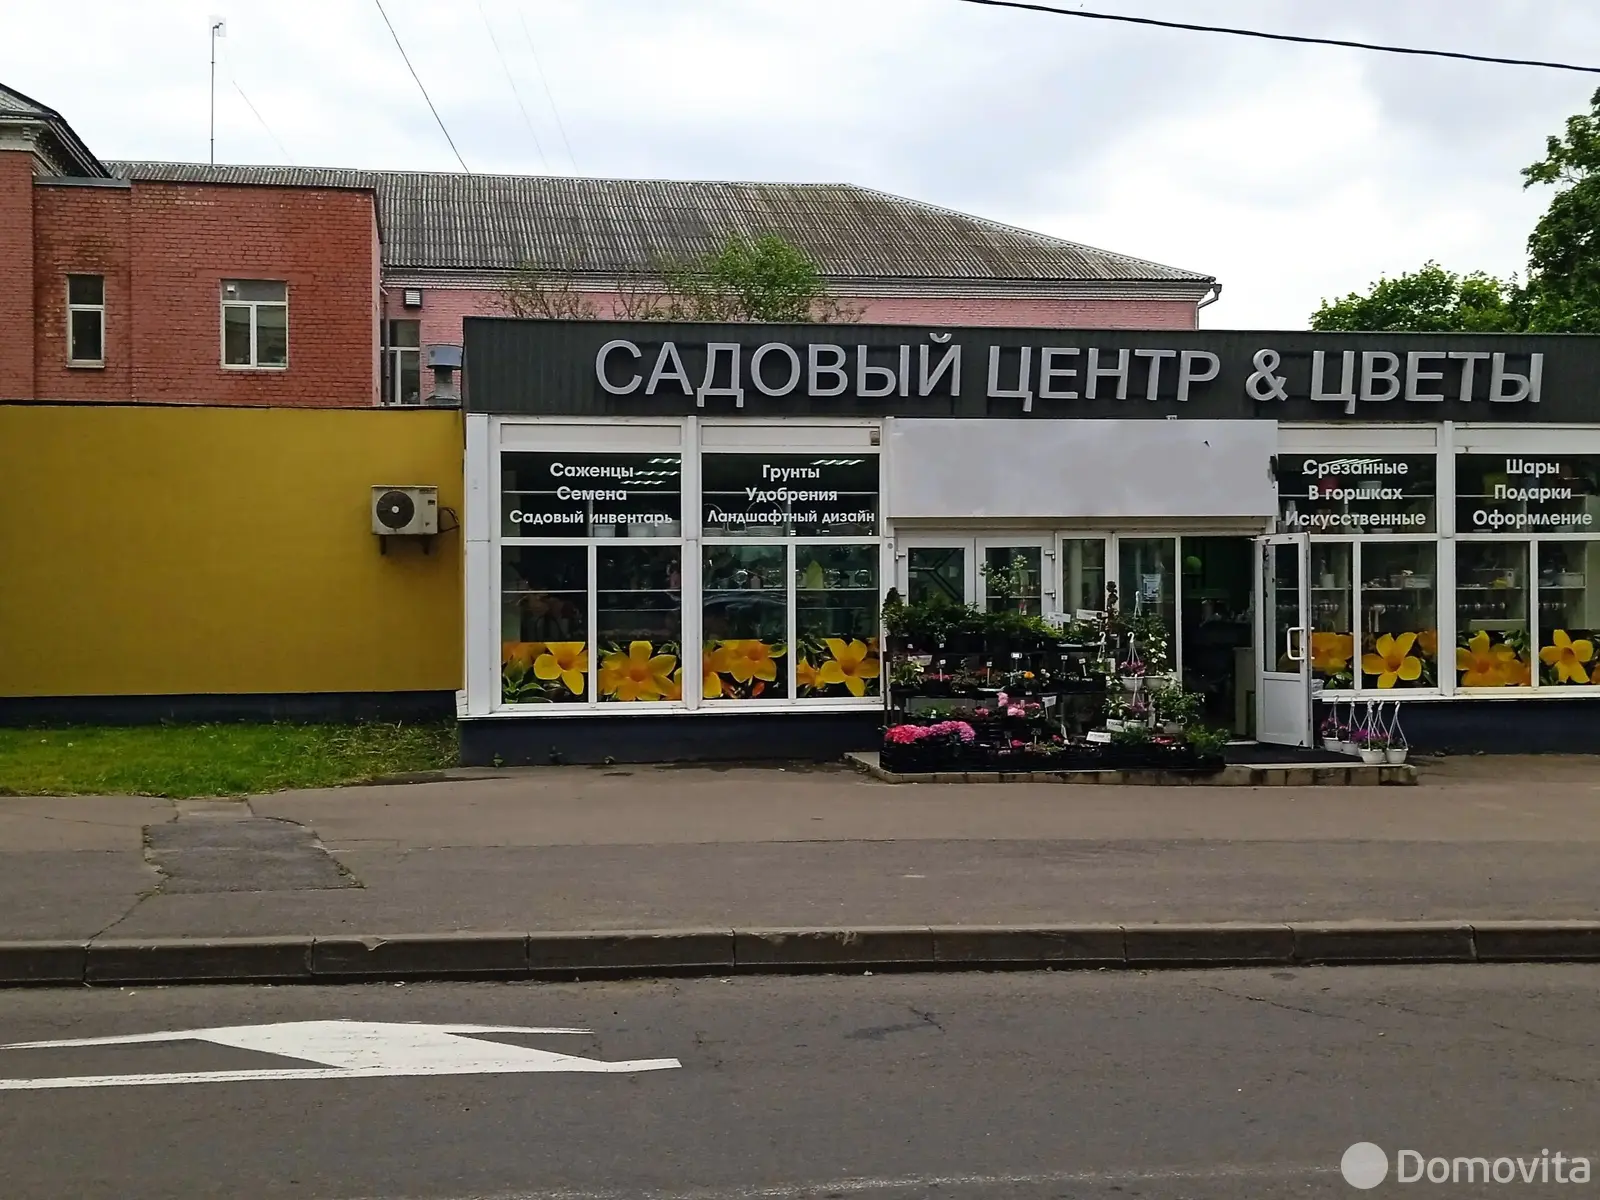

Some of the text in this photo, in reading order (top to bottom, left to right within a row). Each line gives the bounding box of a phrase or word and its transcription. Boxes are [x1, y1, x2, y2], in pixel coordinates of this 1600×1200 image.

[595, 332, 1544, 415] САДОВЫЙ ЦЕНТР & ЦВЕТЫ
[549, 462, 634, 479] Саженцы
[762, 464, 820, 482] Грунты
[1302, 459, 1409, 478] Срезанные
[1506, 458, 1560, 478] Шары
[556, 485, 627, 501] Семена
[745, 487, 838, 504] Удобрения
[1308, 485, 1403, 504] В горшках
[1494, 484, 1571, 503] Подарки
[509, 509, 673, 527] Садовый инвентарь
[707, 510, 875, 525] Ландшафтный дизайн
[1286, 510, 1426, 530] Искусственные
[1472, 509, 1593, 529] Оформление
